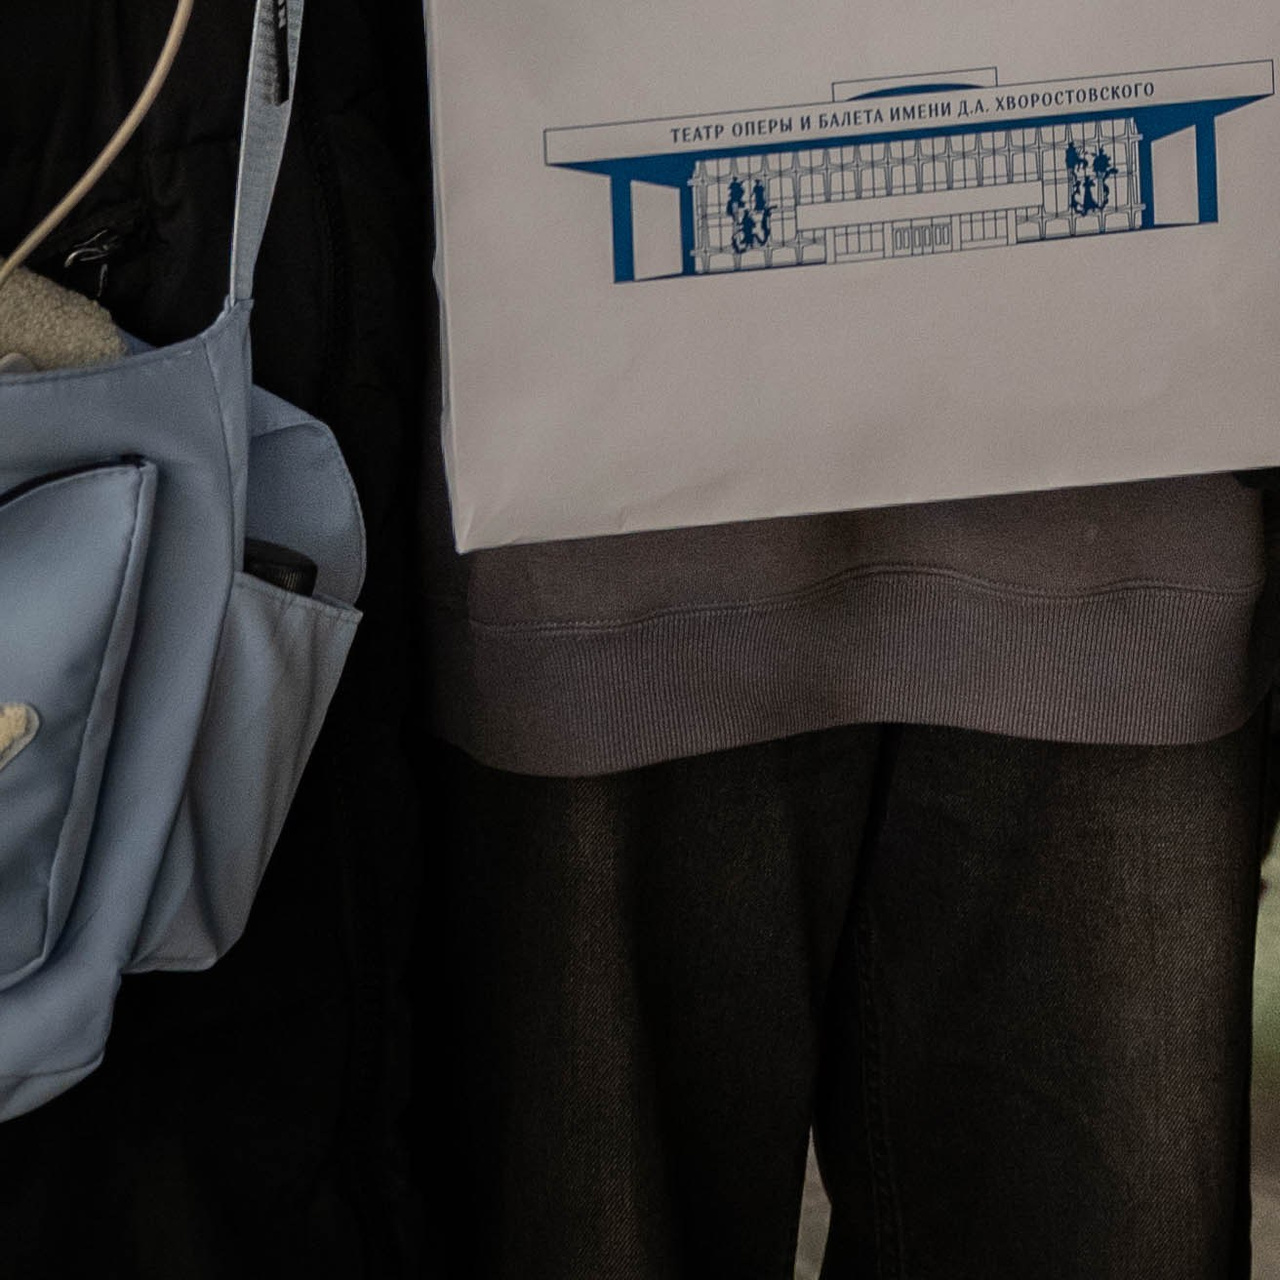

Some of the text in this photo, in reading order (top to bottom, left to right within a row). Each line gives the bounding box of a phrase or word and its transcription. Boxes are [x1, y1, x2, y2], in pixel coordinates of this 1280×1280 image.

[670, 81, 1156, 144] ТЕАТР ОПЕРЫ И БАЛЕТА ИМЕНИ Д.А. ХВОРОСТОВСКОГО
